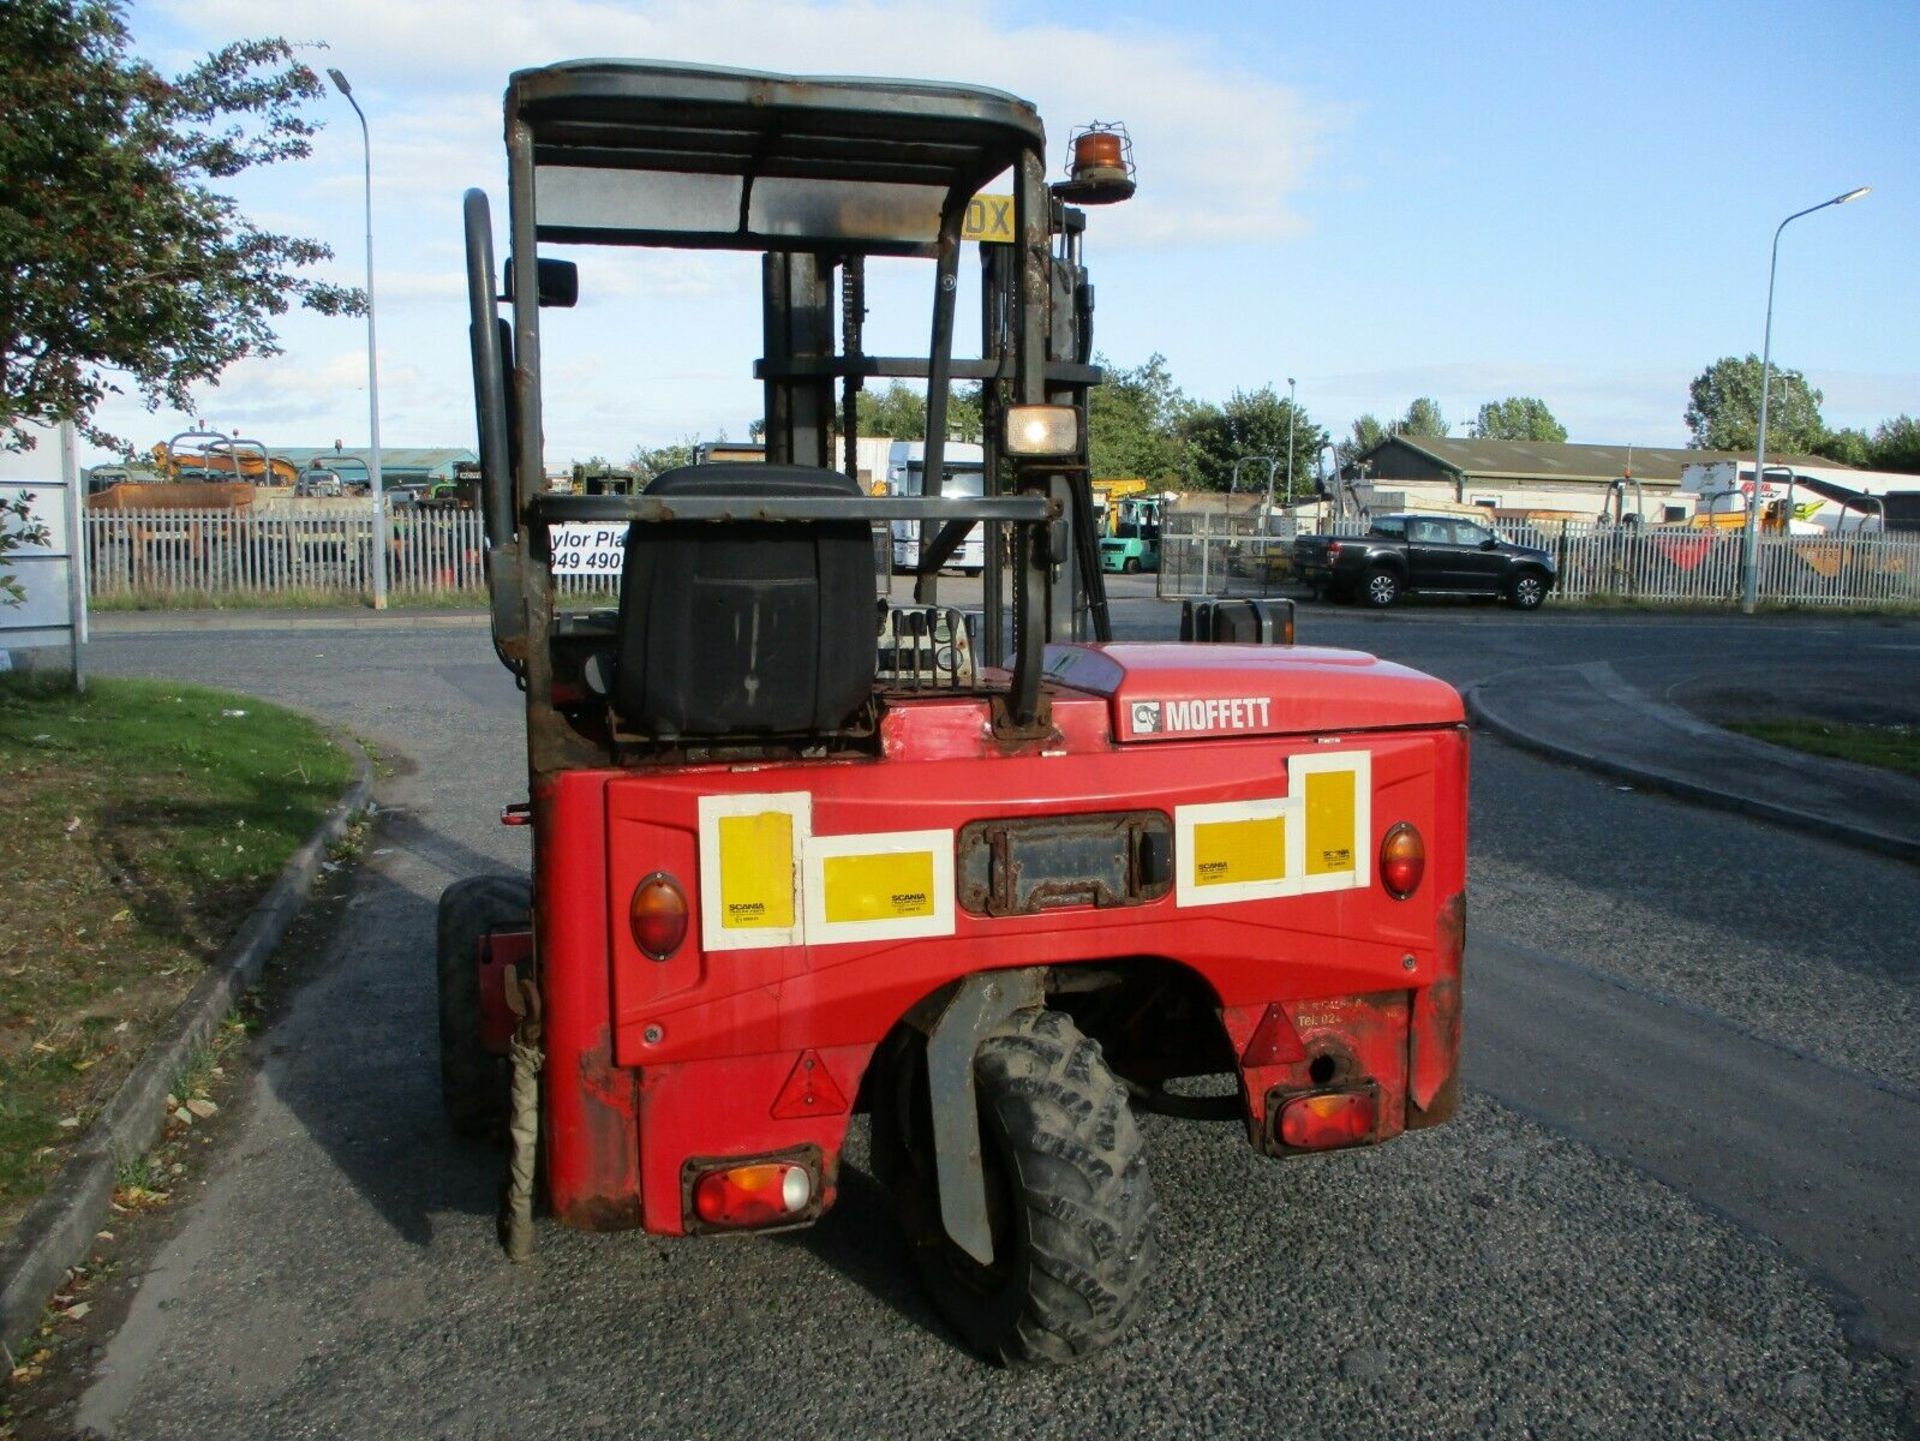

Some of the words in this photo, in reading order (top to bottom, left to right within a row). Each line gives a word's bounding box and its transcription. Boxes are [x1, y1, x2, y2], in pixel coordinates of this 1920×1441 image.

[1165, 697, 1271, 731] MOFFETT
[1323, 849, 1350, 857] SCANIA
[1198, 861, 1228, 870] SCANIA
[892, 893, 926, 901] SCANIA
[728, 903, 765, 911] SCANIA
